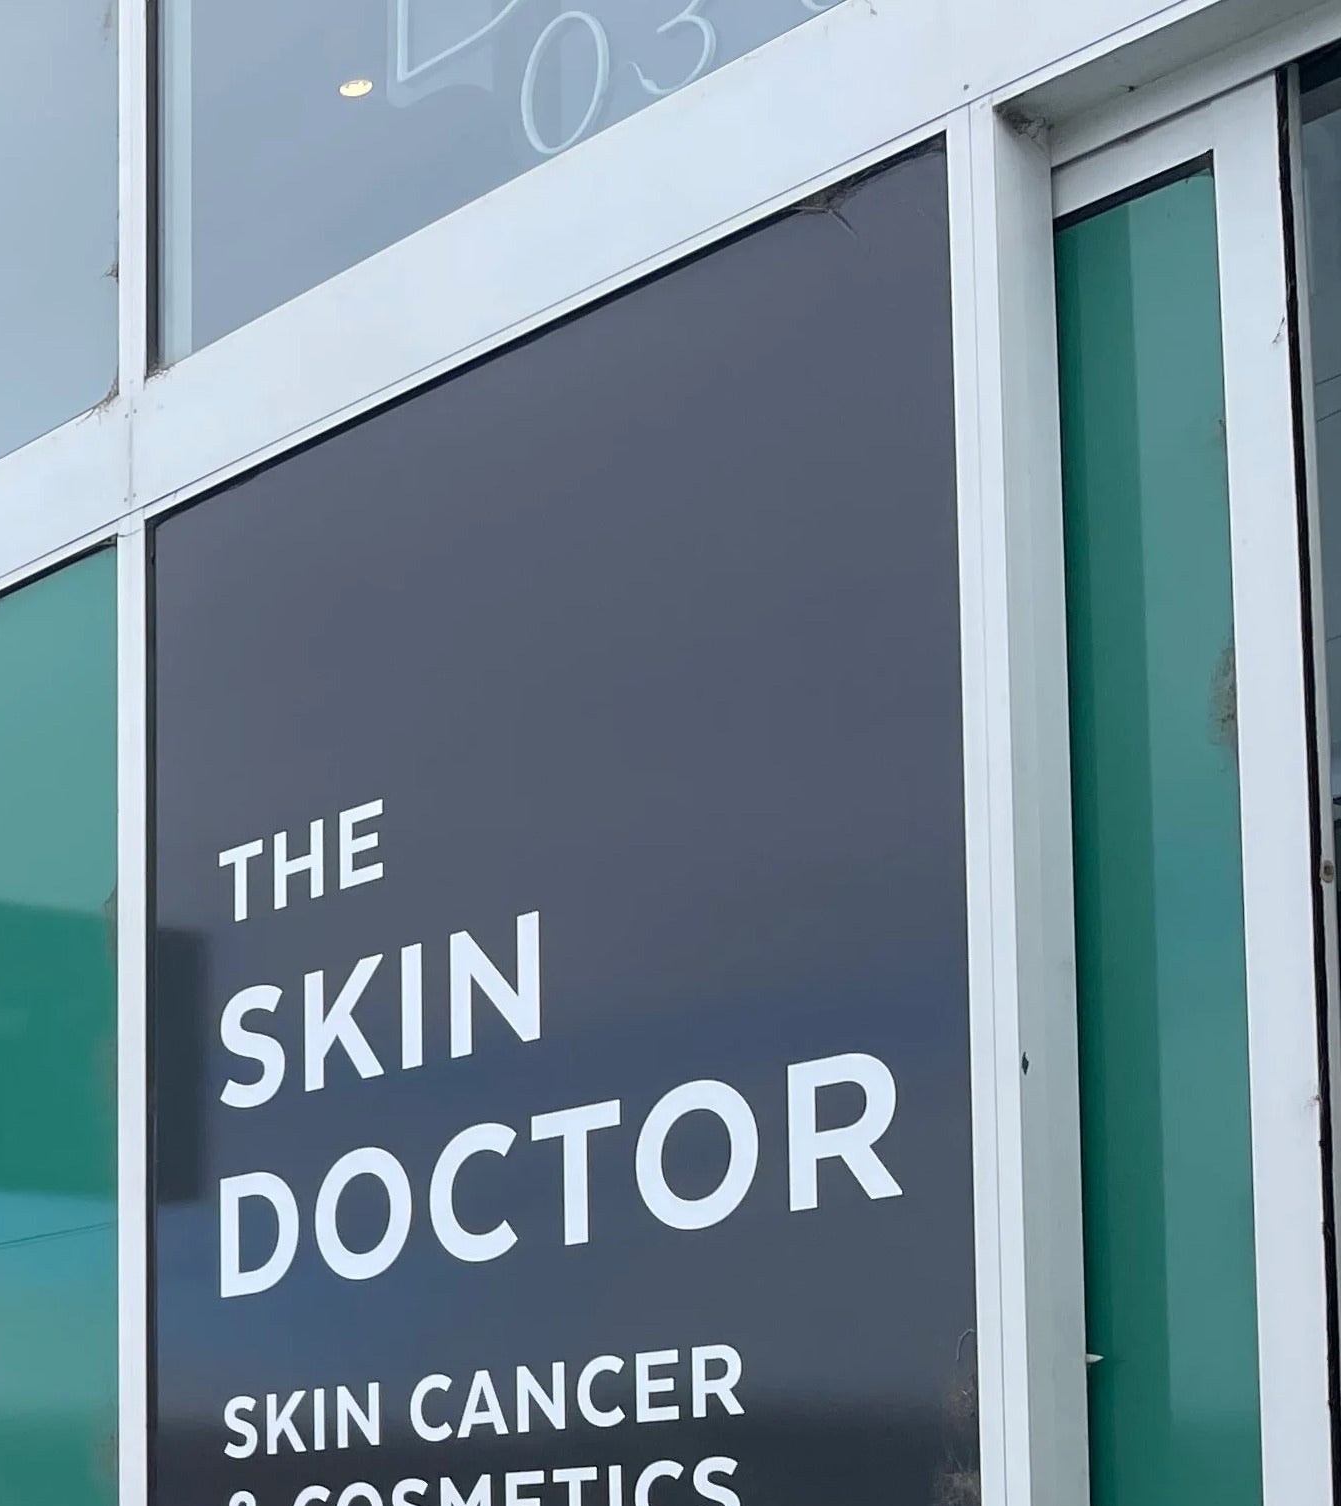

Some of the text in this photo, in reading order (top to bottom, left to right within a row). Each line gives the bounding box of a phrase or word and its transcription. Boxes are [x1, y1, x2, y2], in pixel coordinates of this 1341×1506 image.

[218, 798, 385, 922] THE
[218, 910, 541, 1109] SKIN
[218, 1051, 903, 1299] DOCTOR
[223, 1342, 745, 1460] SKIN CANCER
